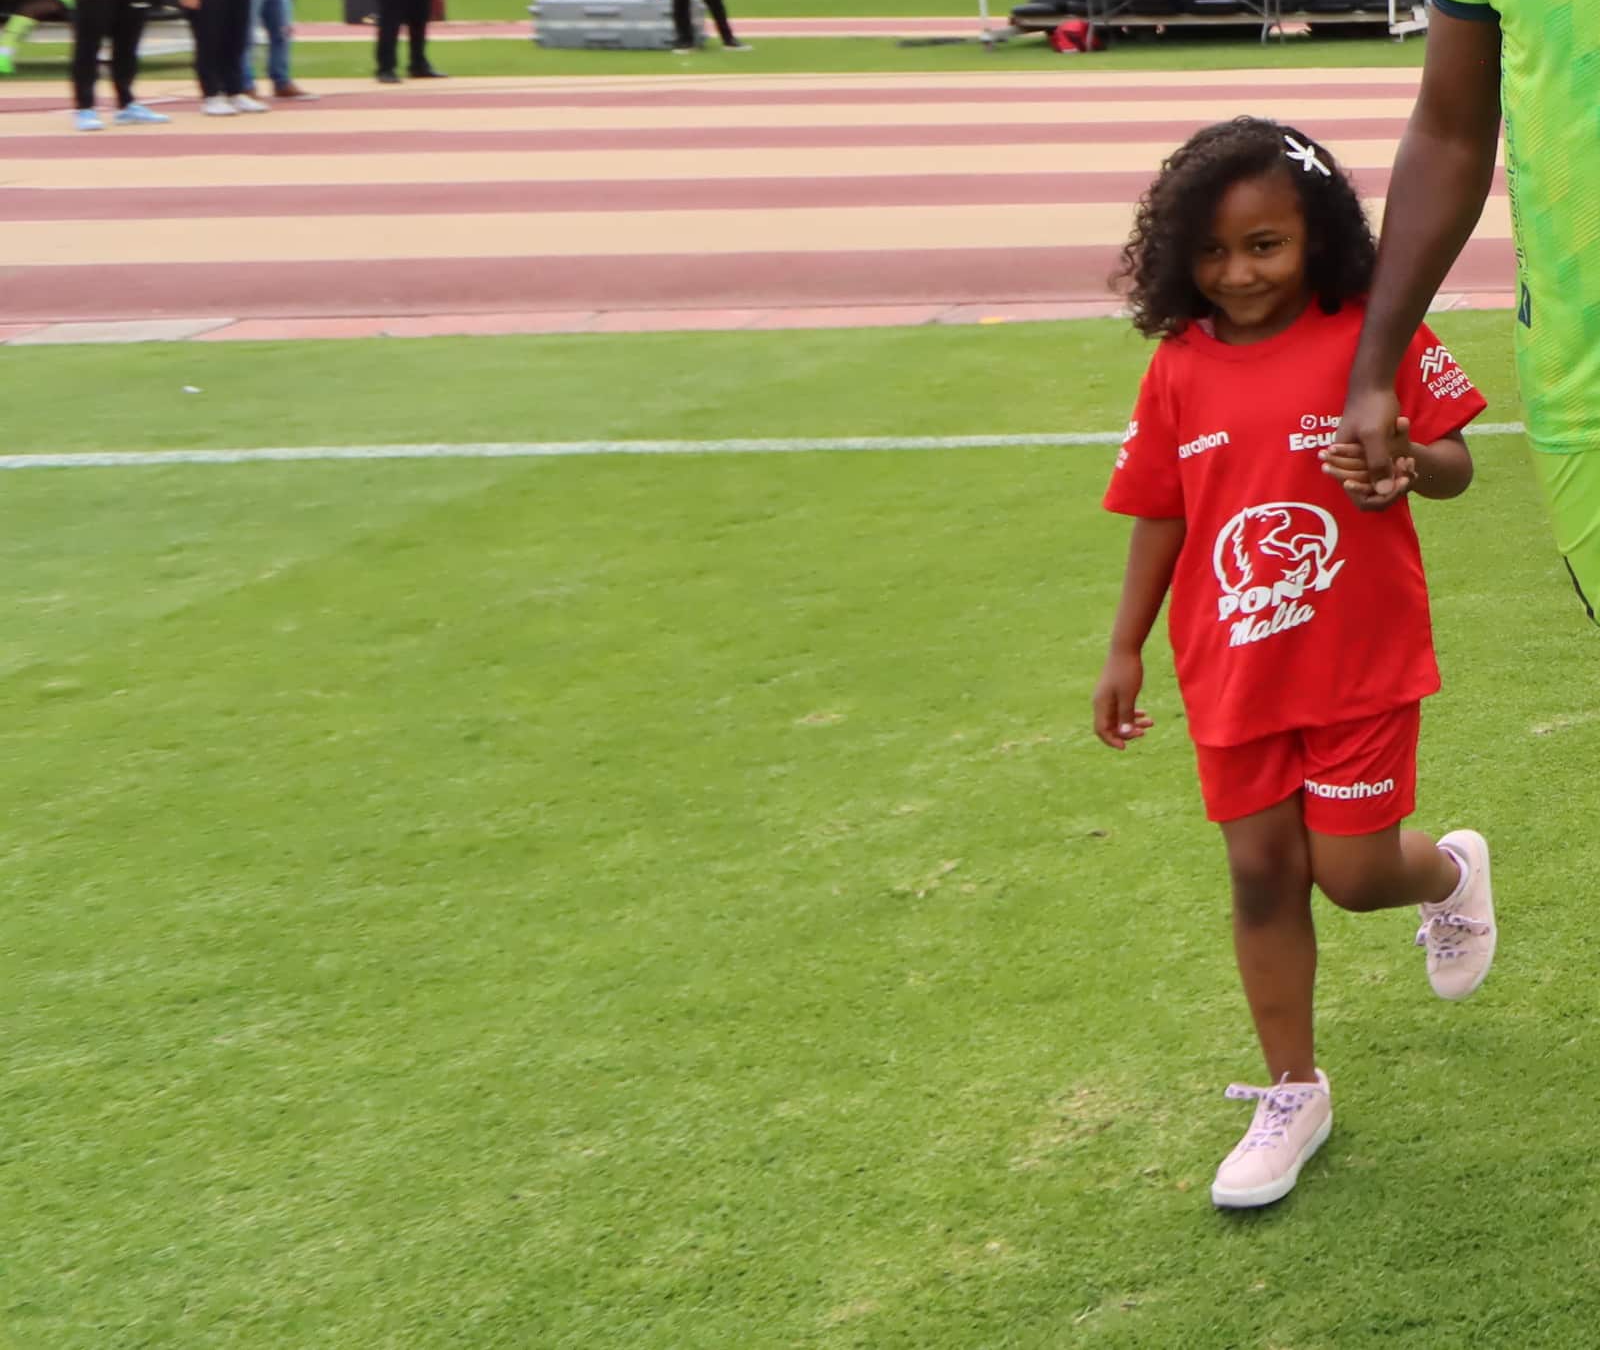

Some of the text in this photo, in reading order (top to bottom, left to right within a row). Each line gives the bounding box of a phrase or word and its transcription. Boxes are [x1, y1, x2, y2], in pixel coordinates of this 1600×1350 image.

[1217, 558, 1346, 622] PONY
[1228, 601, 1316, 648] Malta
[1304, 776, 1395, 800] marathon
